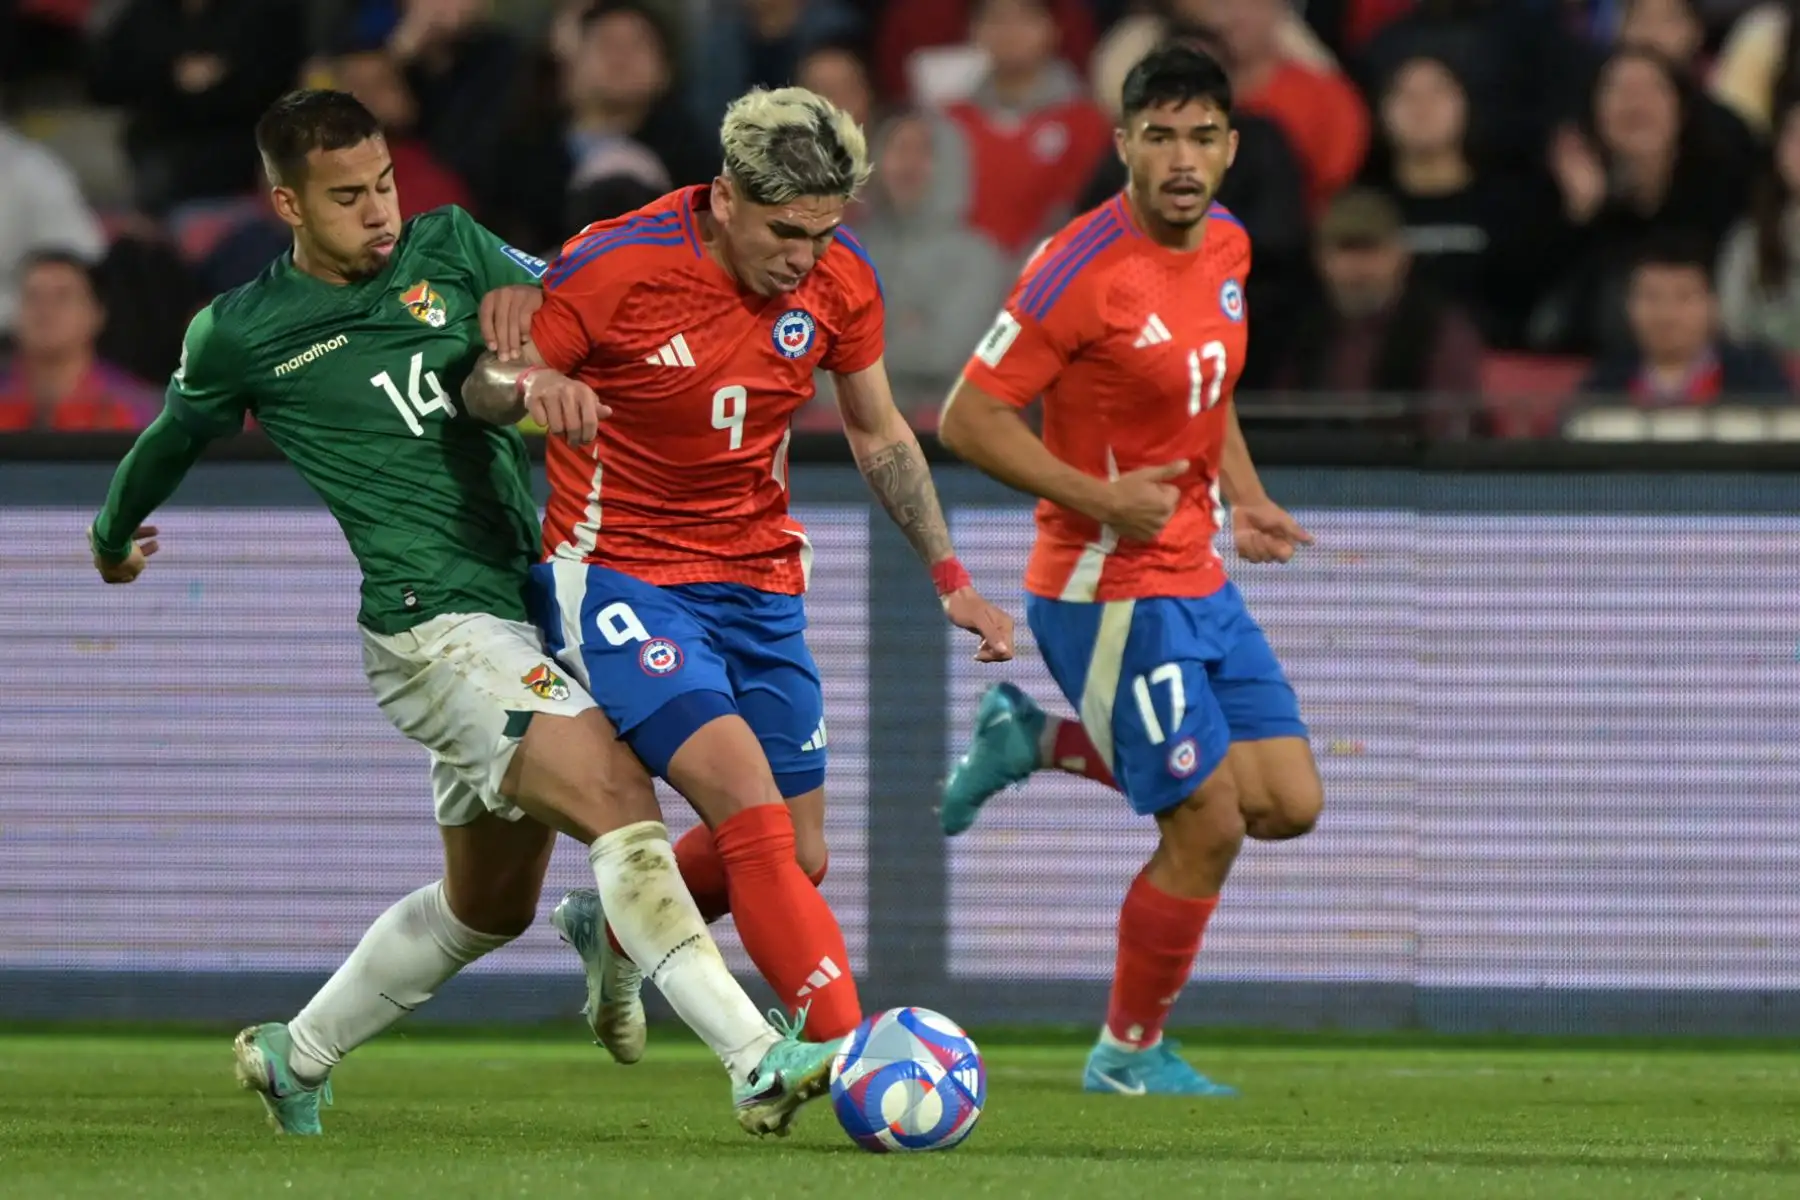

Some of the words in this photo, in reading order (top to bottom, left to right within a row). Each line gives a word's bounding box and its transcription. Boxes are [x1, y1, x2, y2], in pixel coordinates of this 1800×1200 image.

[274, 334, 349, 377] marathon
[1188, 340, 1227, 417] 17
[370, 352, 457, 437] 14
[711, 384, 747, 450] 9
[596, 602, 651, 646] 9
[1132, 662, 1186, 745] 17
